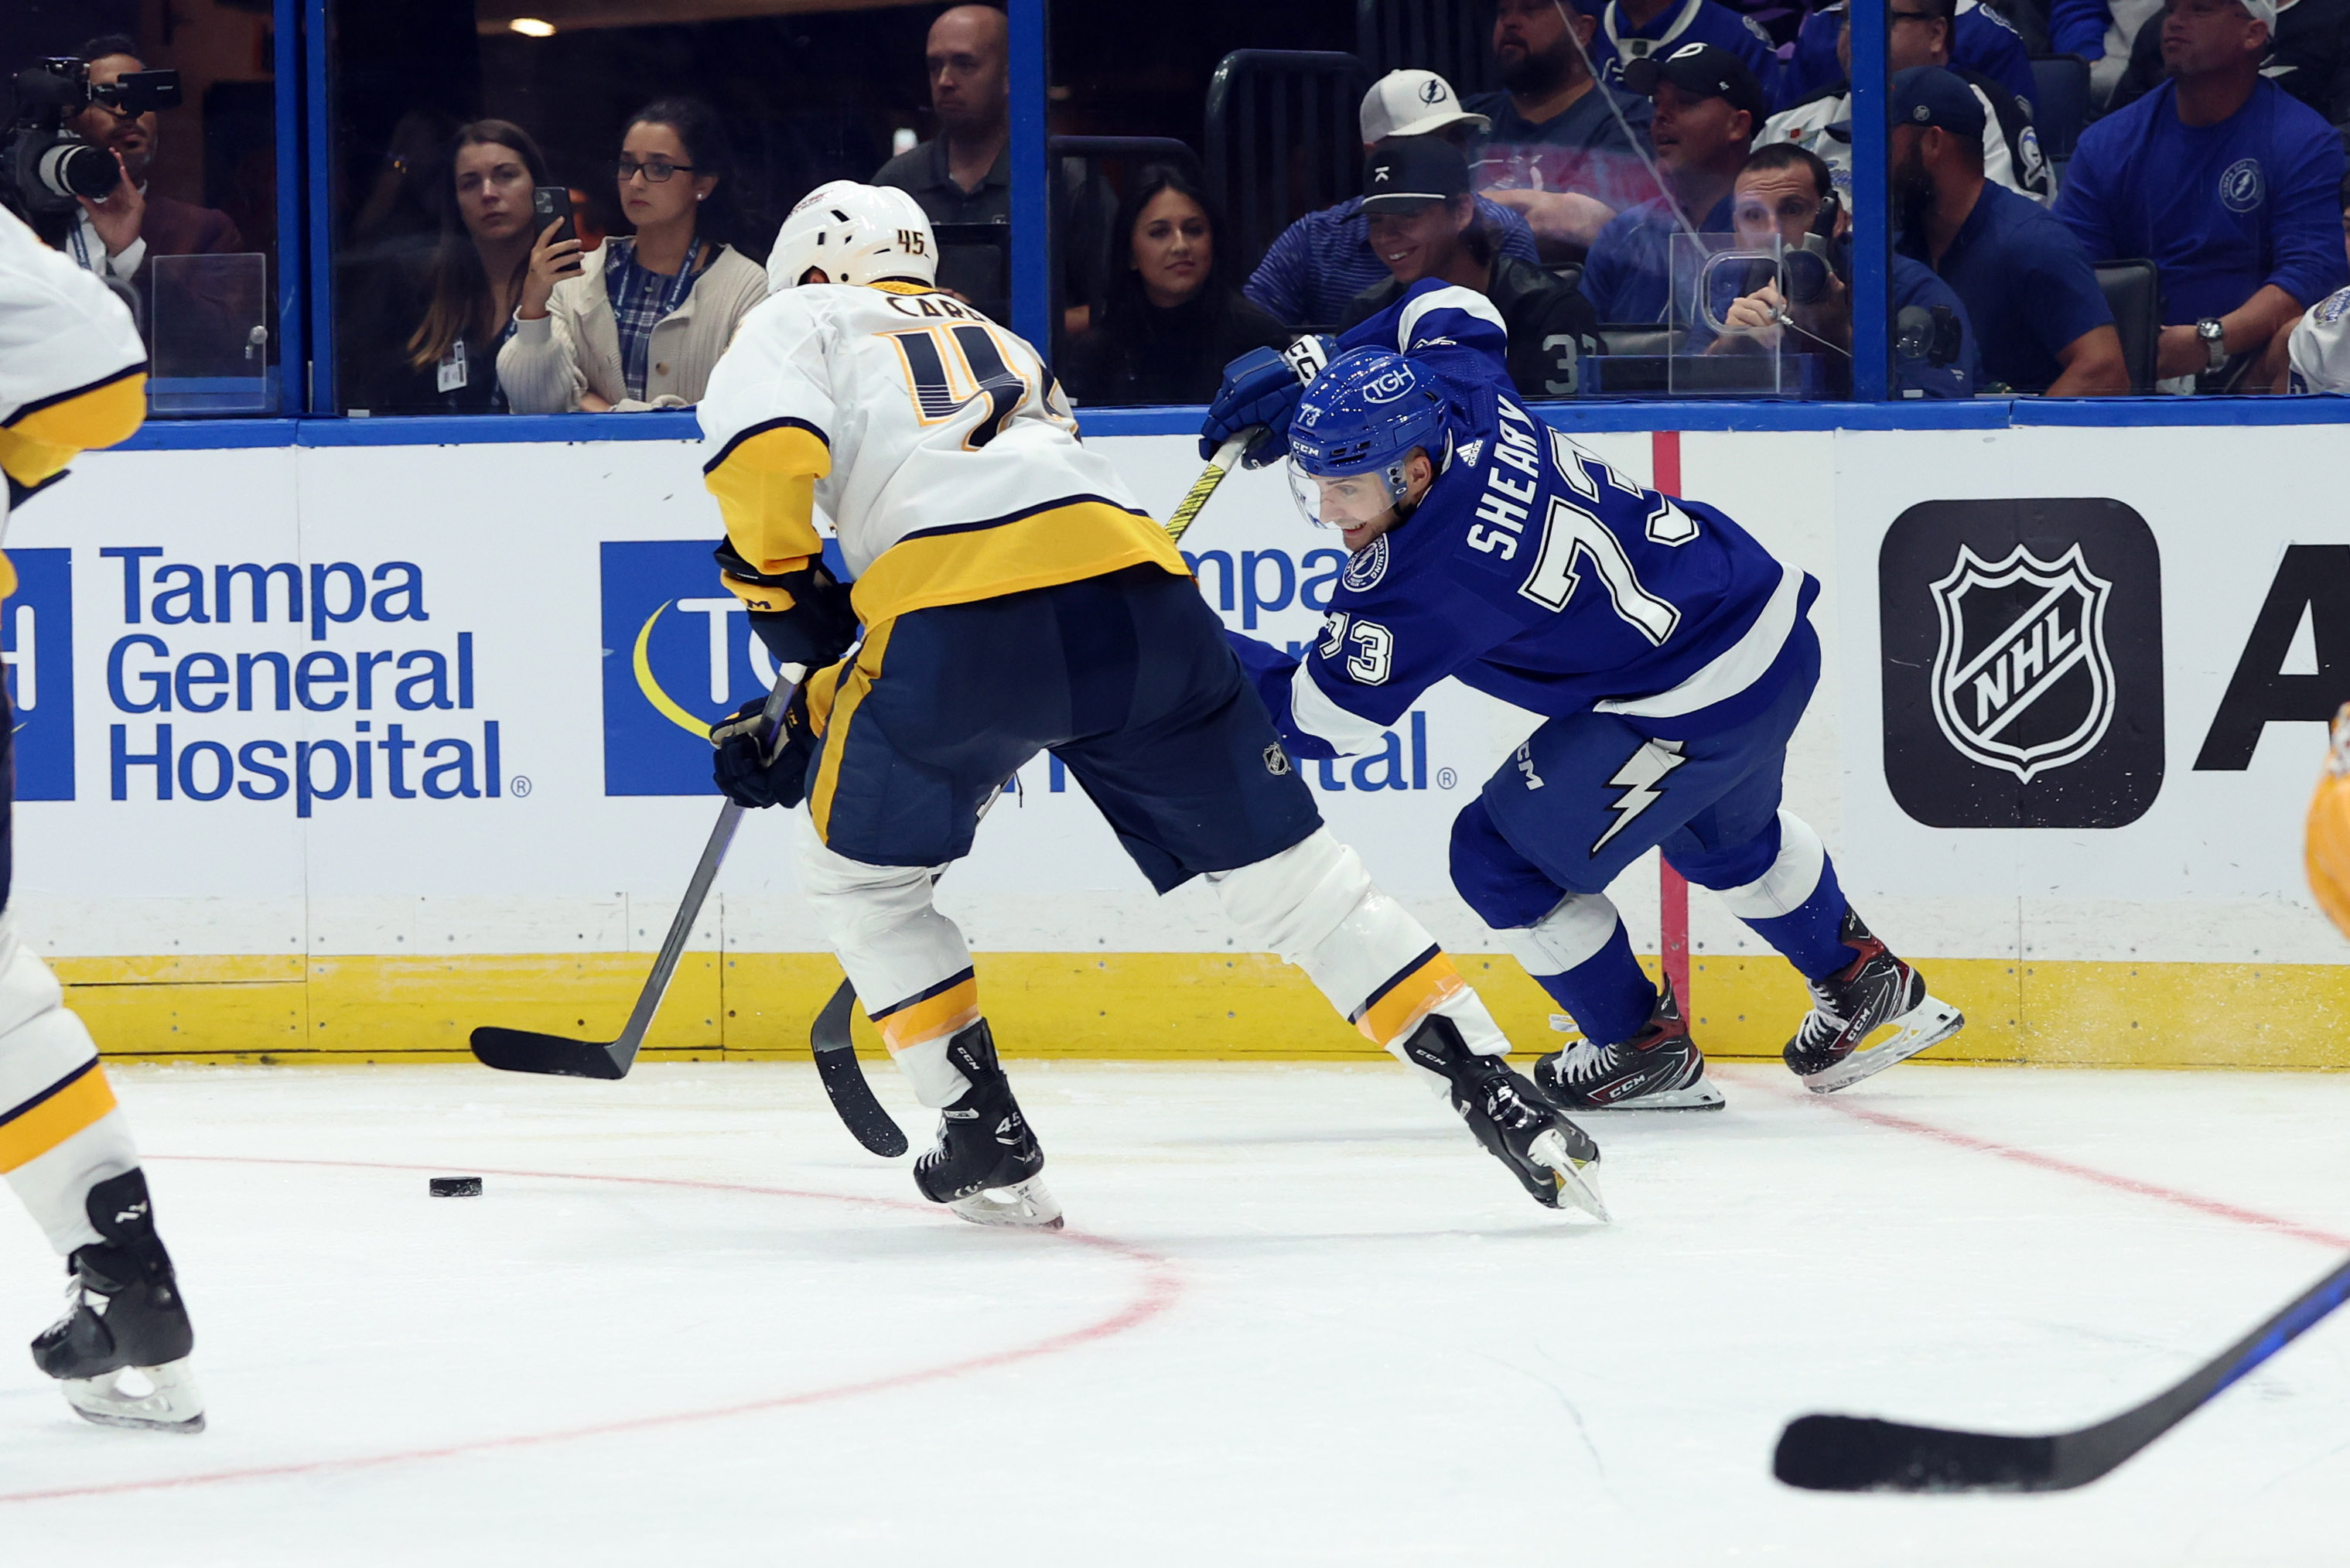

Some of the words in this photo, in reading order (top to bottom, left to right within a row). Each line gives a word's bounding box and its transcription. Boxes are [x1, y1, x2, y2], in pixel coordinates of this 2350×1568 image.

[897, 228, 924, 255] 45
[1367, 362, 1416, 398] TGH
[1296, 402, 1324, 427] 73
[1293, 440, 1320, 456] CCM
[1467, 394, 1539, 561] SHEARY
[1517, 425, 1699, 647] 73
[100, 546, 429, 641] Tampa
[1319, 611, 1394, 686] 73
[107, 631, 474, 713] General
[1973, 606, 2076, 728] NHL
[1516, 740, 1546, 791] CM
[1846, 1006, 1872, 1041] CCM
[957, 1046, 981, 1071] CCM
[1415, 1048, 1447, 1066] CCM
[1487, 1085, 1514, 1116] 45
[1608, 1074, 1645, 1099] CCM
[995, 1111, 1022, 1135] 45
